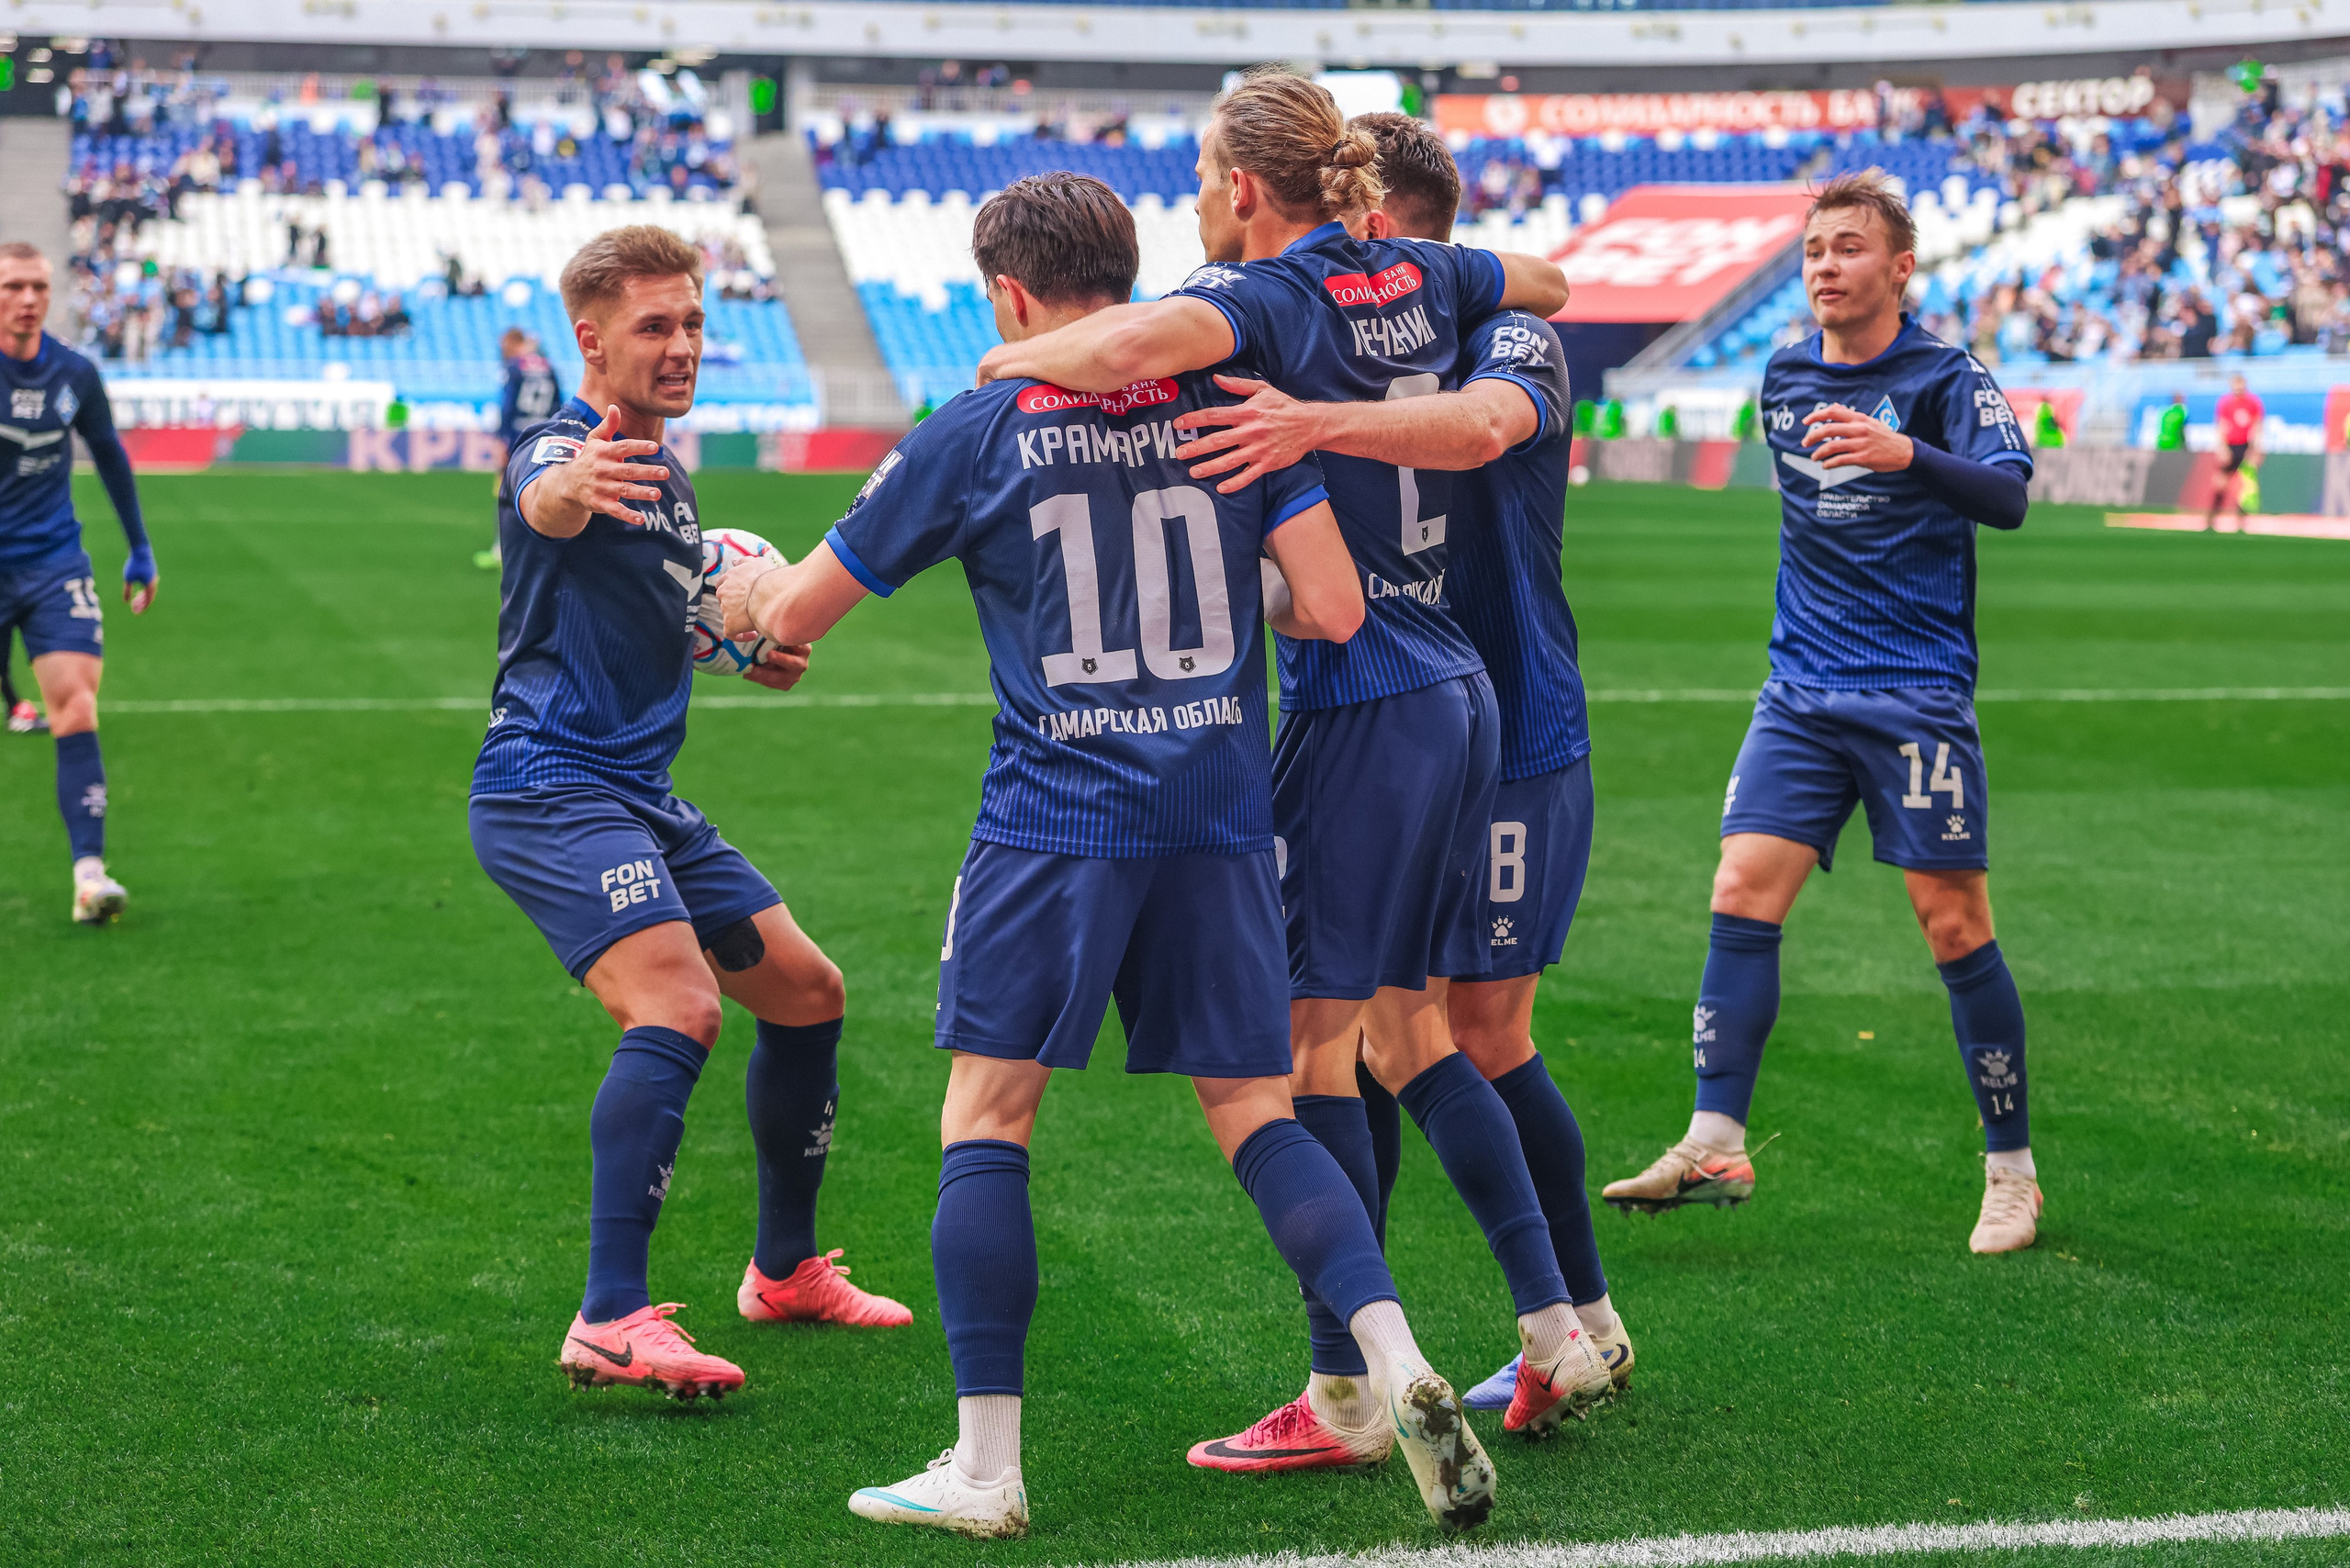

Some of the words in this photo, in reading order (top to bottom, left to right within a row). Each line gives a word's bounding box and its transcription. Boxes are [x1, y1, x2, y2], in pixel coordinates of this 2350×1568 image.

[1383, 265, 1406, 281] БАНК
[1491, 341, 1545, 366] BET
[1492, 326, 1550, 354] FON
[1029, 387, 1169, 413] СОЛИДРНОСТЬ
[1029, 485, 1236, 688] 10
[1898, 742, 1964, 809] 14
[600, 859, 655, 893] FON
[1489, 821, 1528, 903] 8
[610, 879, 661, 913] BET
[1491, 937, 1518, 946] ELME
[1991, 1092, 2015, 1115] 14
